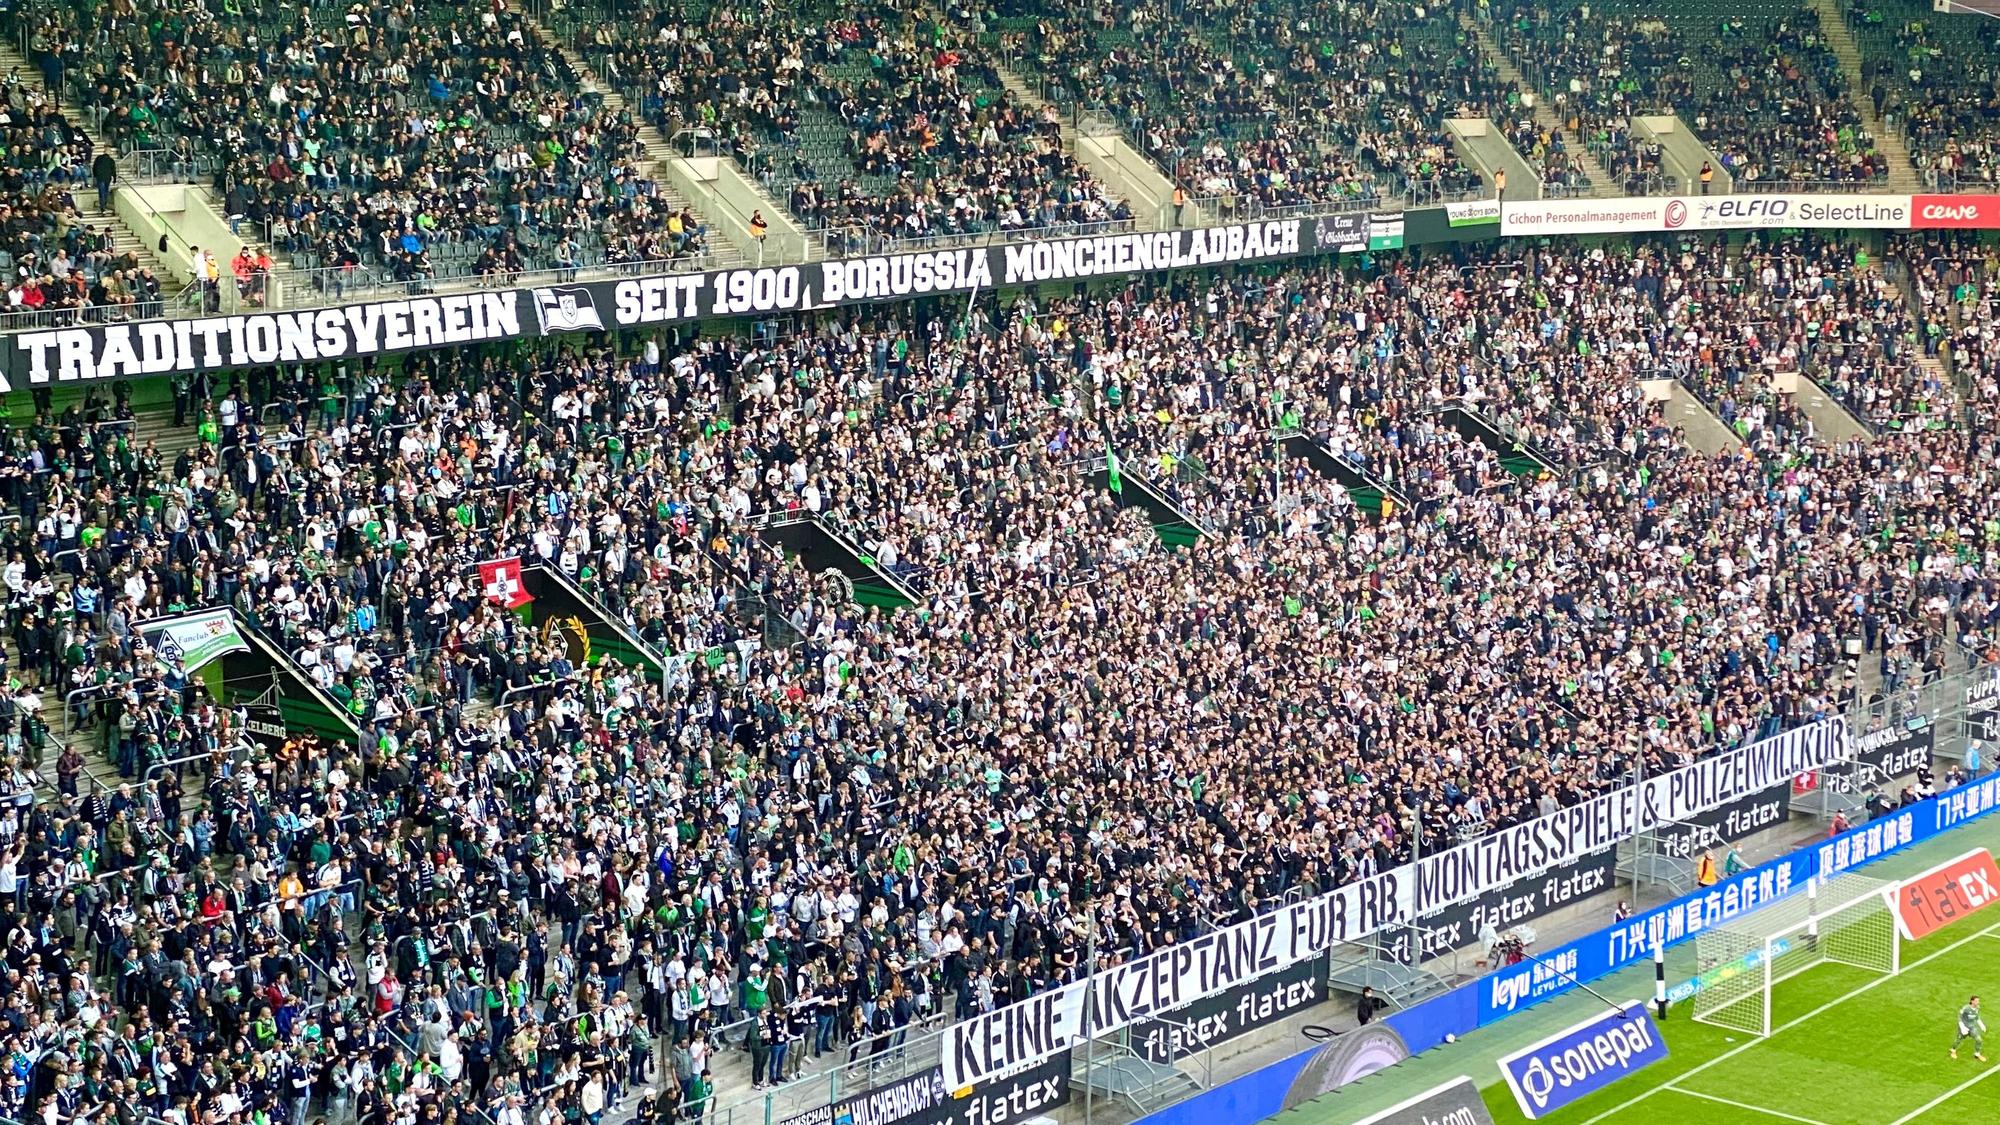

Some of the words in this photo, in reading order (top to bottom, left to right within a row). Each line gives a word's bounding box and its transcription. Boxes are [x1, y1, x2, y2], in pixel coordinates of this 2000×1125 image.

[1508, 212, 1542, 225] Cichon
[1546, 210, 1657, 225] Personalmanagement
[1922, 204, 1979, 220] cewe
[17, 291, 521, 384] TRADITIONSVEREIN
[615, 275, 705, 324] SEIT
[711, 267, 800, 314] 1900
[822, 248, 992, 302] BORUSSIA
[178, 633, 209, 643] Fanclub
[954, 991, 1066, 1086] KEINE
[1079, 914, 1278, 1036] AKZEPTANZ
[1416, 789, 1633, 911] MONTAGSSPIELE
[1641, 782, 1660, 827] &
[1670, 718, 1844, 818] POLIZEIWILLKÜR
[1550, 1014, 1654, 1087] sonepar
[850, 1075, 930, 1125] HILCHENBACH
